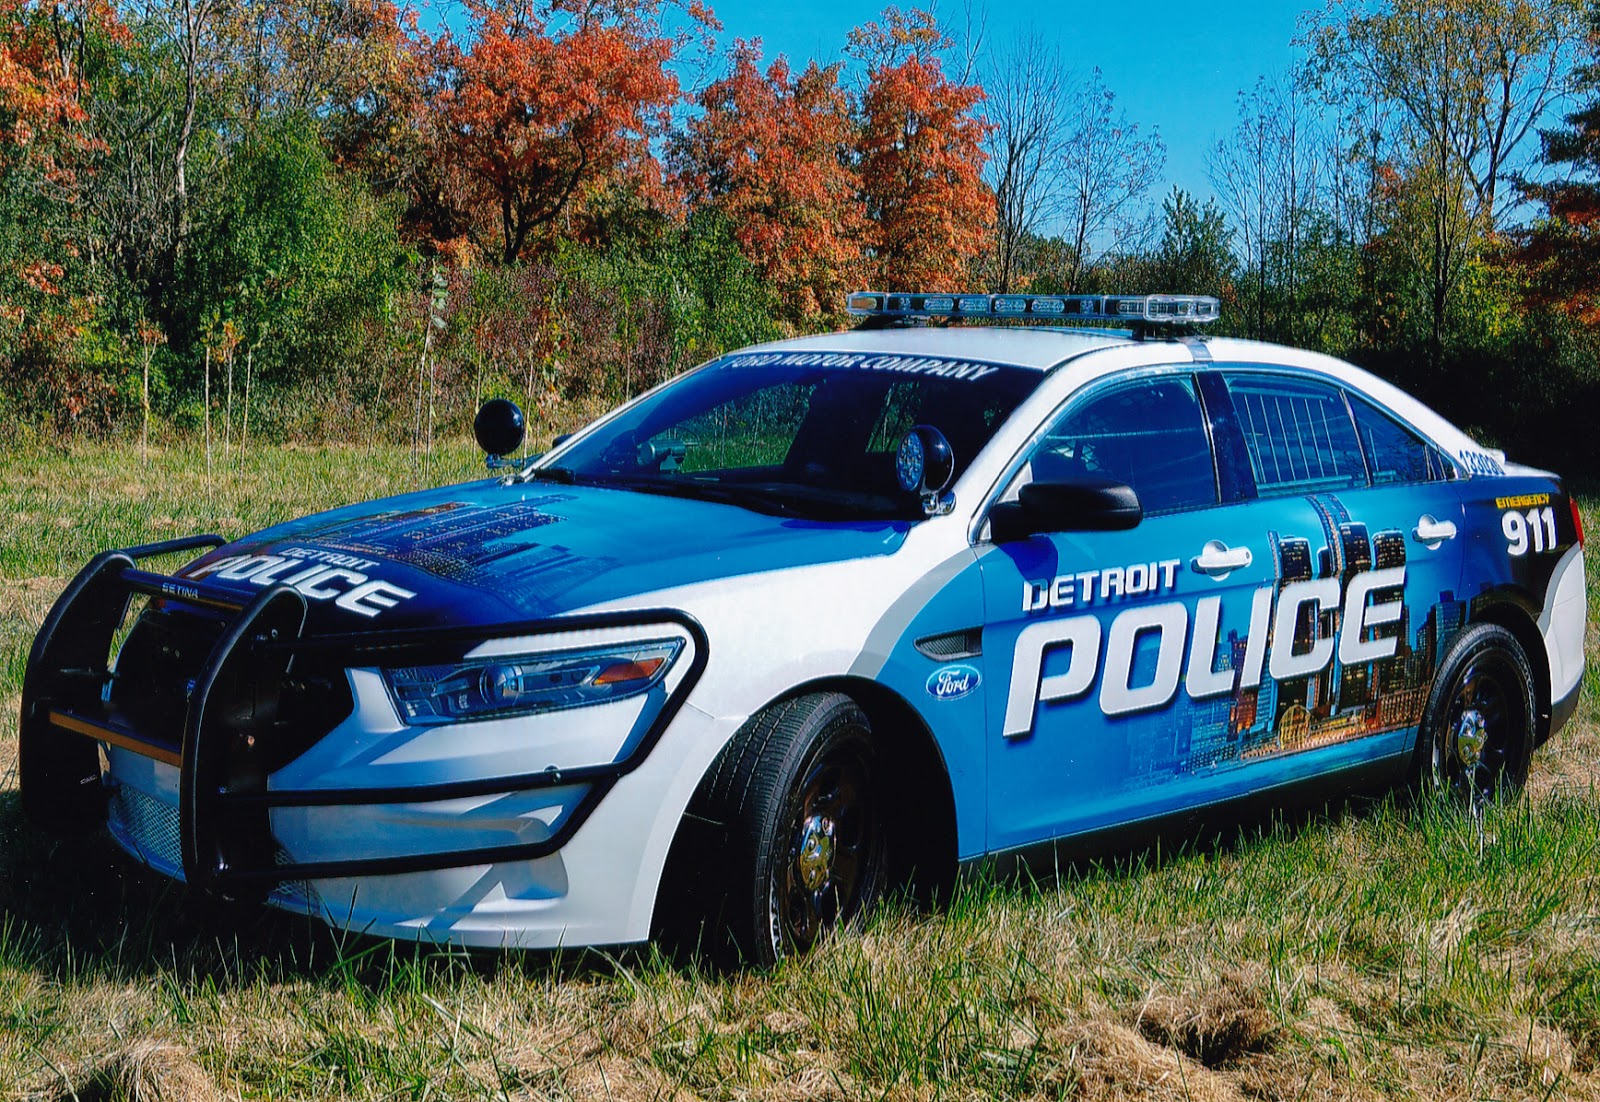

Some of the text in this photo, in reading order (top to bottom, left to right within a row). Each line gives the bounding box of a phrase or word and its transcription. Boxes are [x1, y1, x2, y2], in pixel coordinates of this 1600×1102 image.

[775, 353, 864, 368] MOTOR
[860, 355, 999, 381] COMPANY
[1495, 493, 1550, 509] EMERGENCY
[1501, 506, 1557, 555] 911
[279, 547, 381, 570] DETROIT
[162, 582, 199, 599] SETINA
[186, 554, 418, 617] POLICE
[1022, 558, 1181, 612] DETROIT
[1003, 566, 1406, 738] POLICE
[936, 670, 969, 695] Ford
